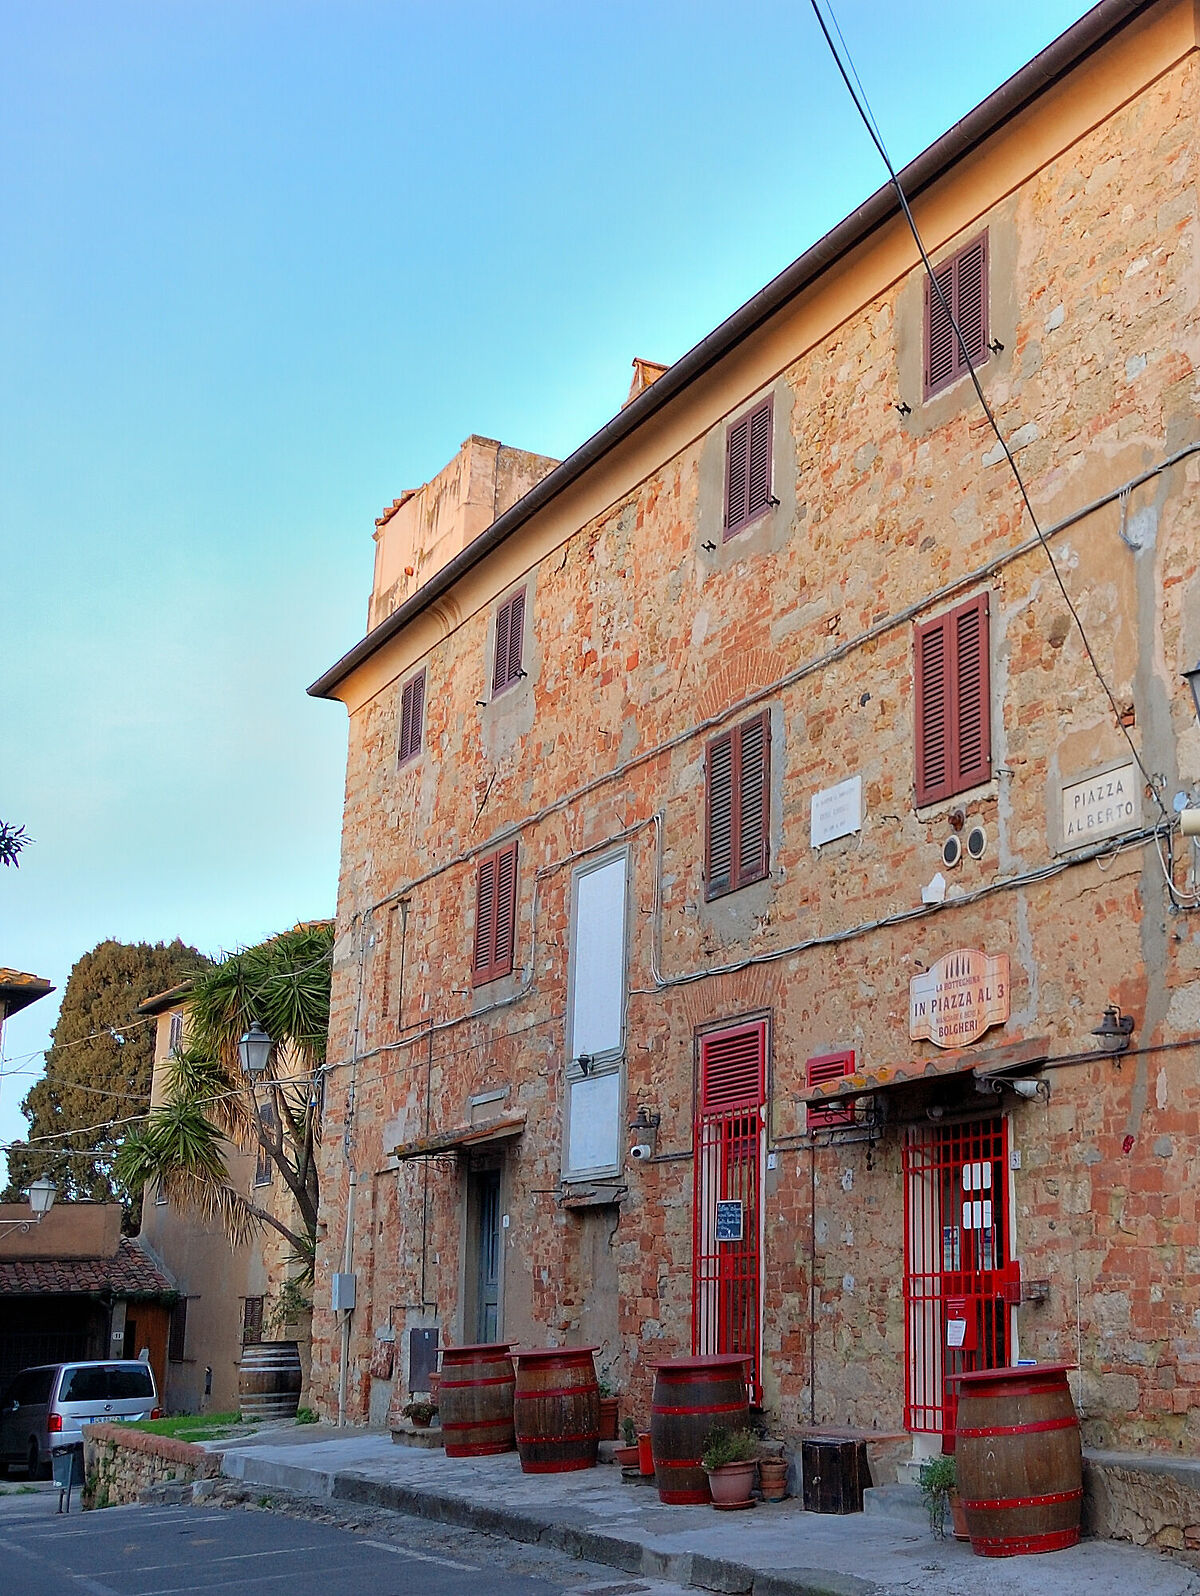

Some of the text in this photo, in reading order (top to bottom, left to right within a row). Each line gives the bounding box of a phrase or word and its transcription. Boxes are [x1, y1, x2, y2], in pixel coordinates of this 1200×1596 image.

[1074, 779, 1124, 809] PIAZZA
[1067, 801, 1133, 836] ALBERTO
[914, 1002, 926, 1017] IN
[931, 991, 972, 1013] PIAZZA
[977, 987, 992, 1003] AL
[997, 983, 1004, 998] 3
[935, 984, 943, 993] LA
[938, 1019, 978, 1038] BOLGHERI
